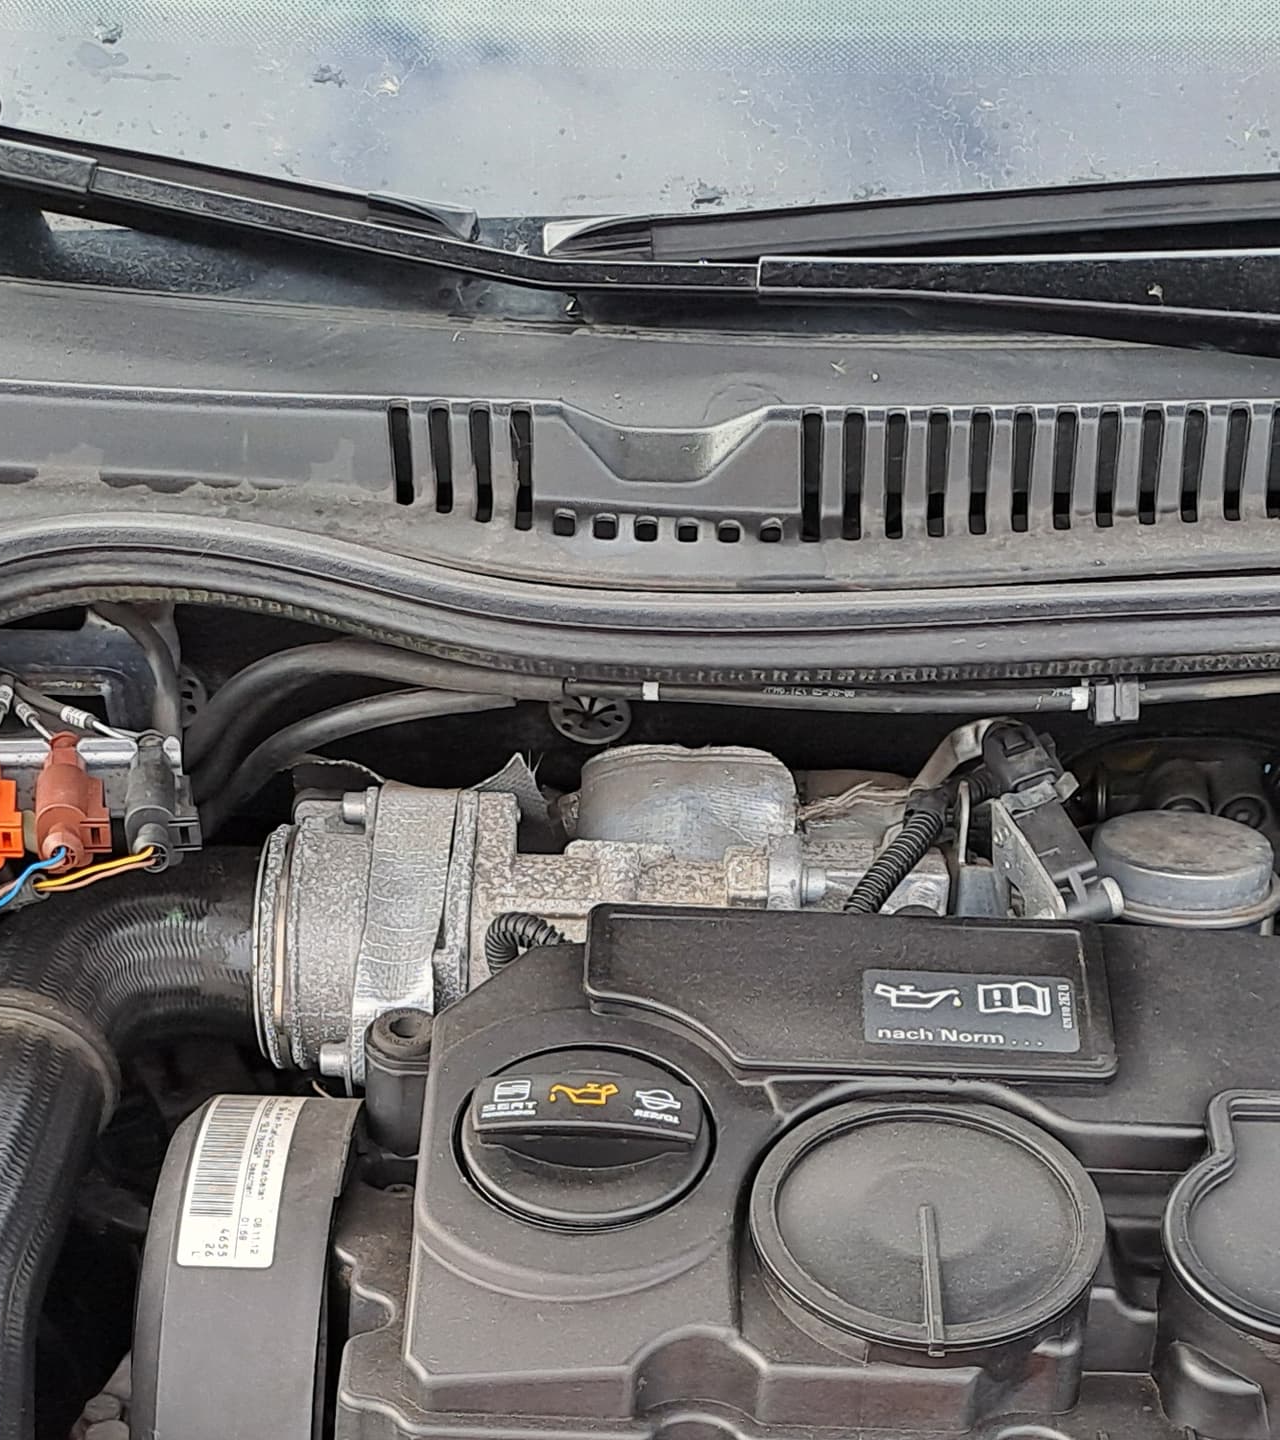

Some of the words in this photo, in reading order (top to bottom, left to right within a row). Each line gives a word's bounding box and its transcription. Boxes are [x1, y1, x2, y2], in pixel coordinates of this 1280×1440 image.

[877, 1027, 934, 1041] nach
[941, 1029, 1005, 1045] Norm
[482, 1101, 538, 1112] SEAT
[633, 1108, 681, 1125] REPSOL
[204, 1243, 216, 1257] 26
[216, 1228, 229, 1257] 4655
